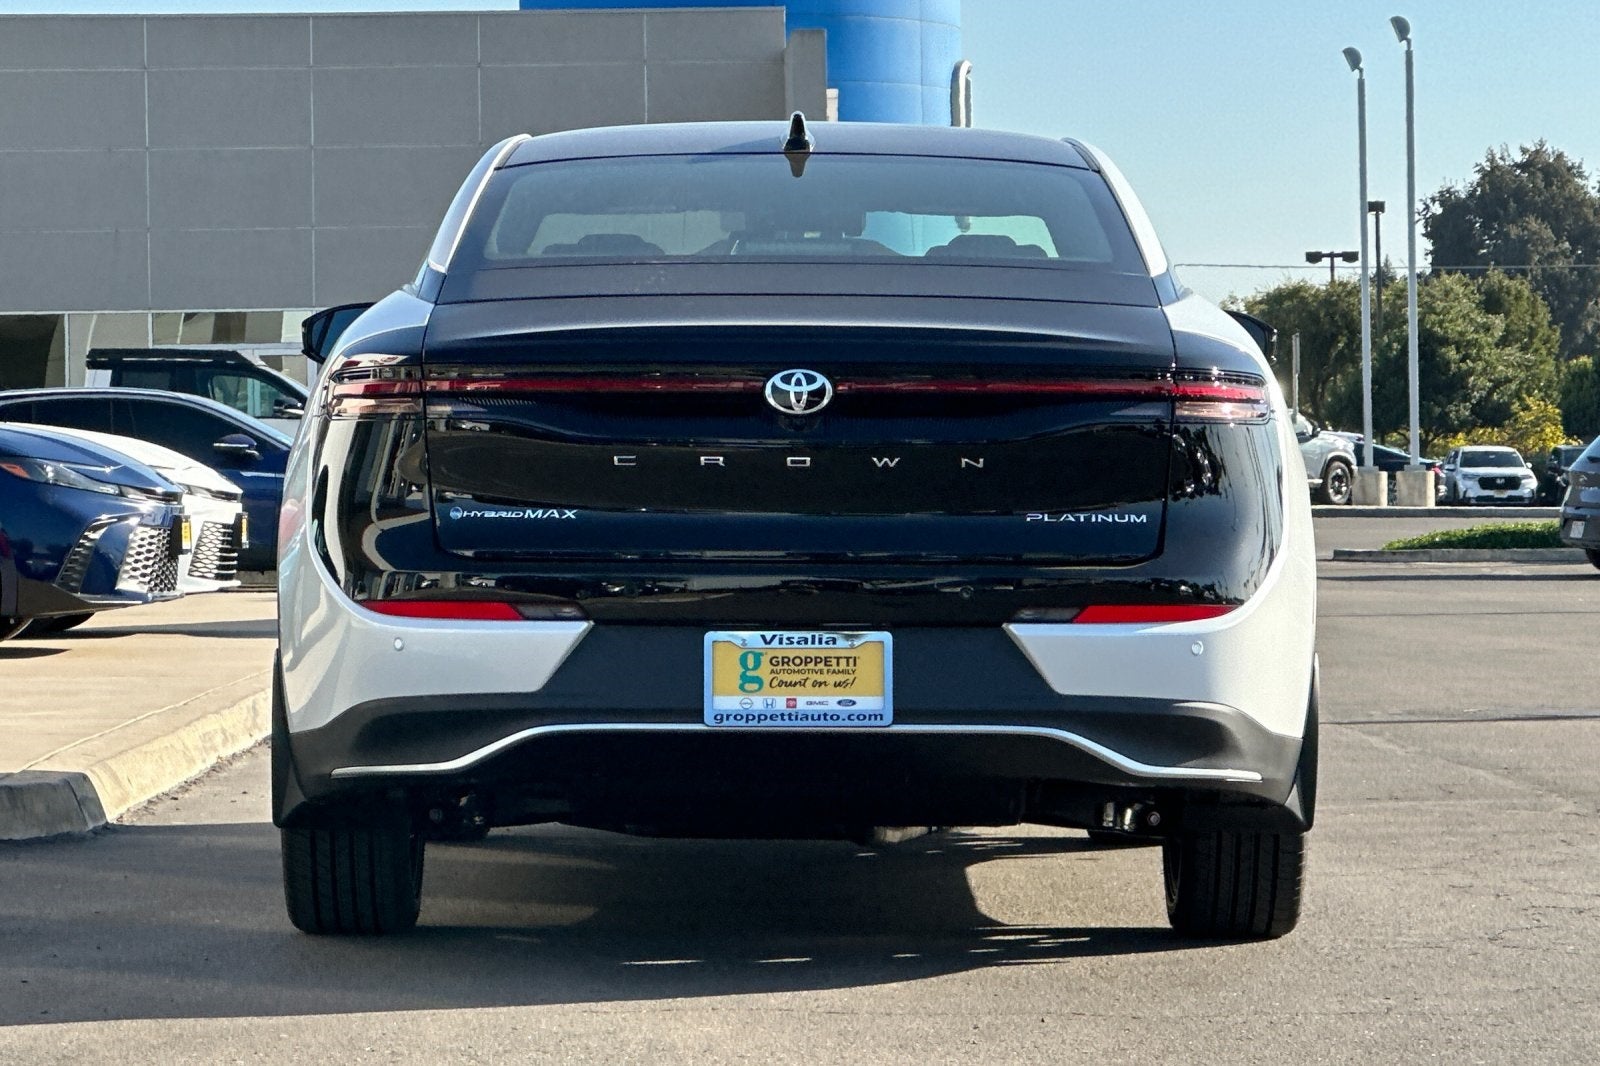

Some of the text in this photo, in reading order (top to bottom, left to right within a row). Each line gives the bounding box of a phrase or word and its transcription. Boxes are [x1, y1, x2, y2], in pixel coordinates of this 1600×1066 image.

[613, 455, 984, 468] CROWN
[1025, 513, 1147, 523] PLATINUM
[760, 634, 837, 646] Visalia
[769, 656, 857, 667] GROPPETTI
[769, 676, 857, 688] Count on us!
[713, 711, 884, 724] groppettiauto.com
